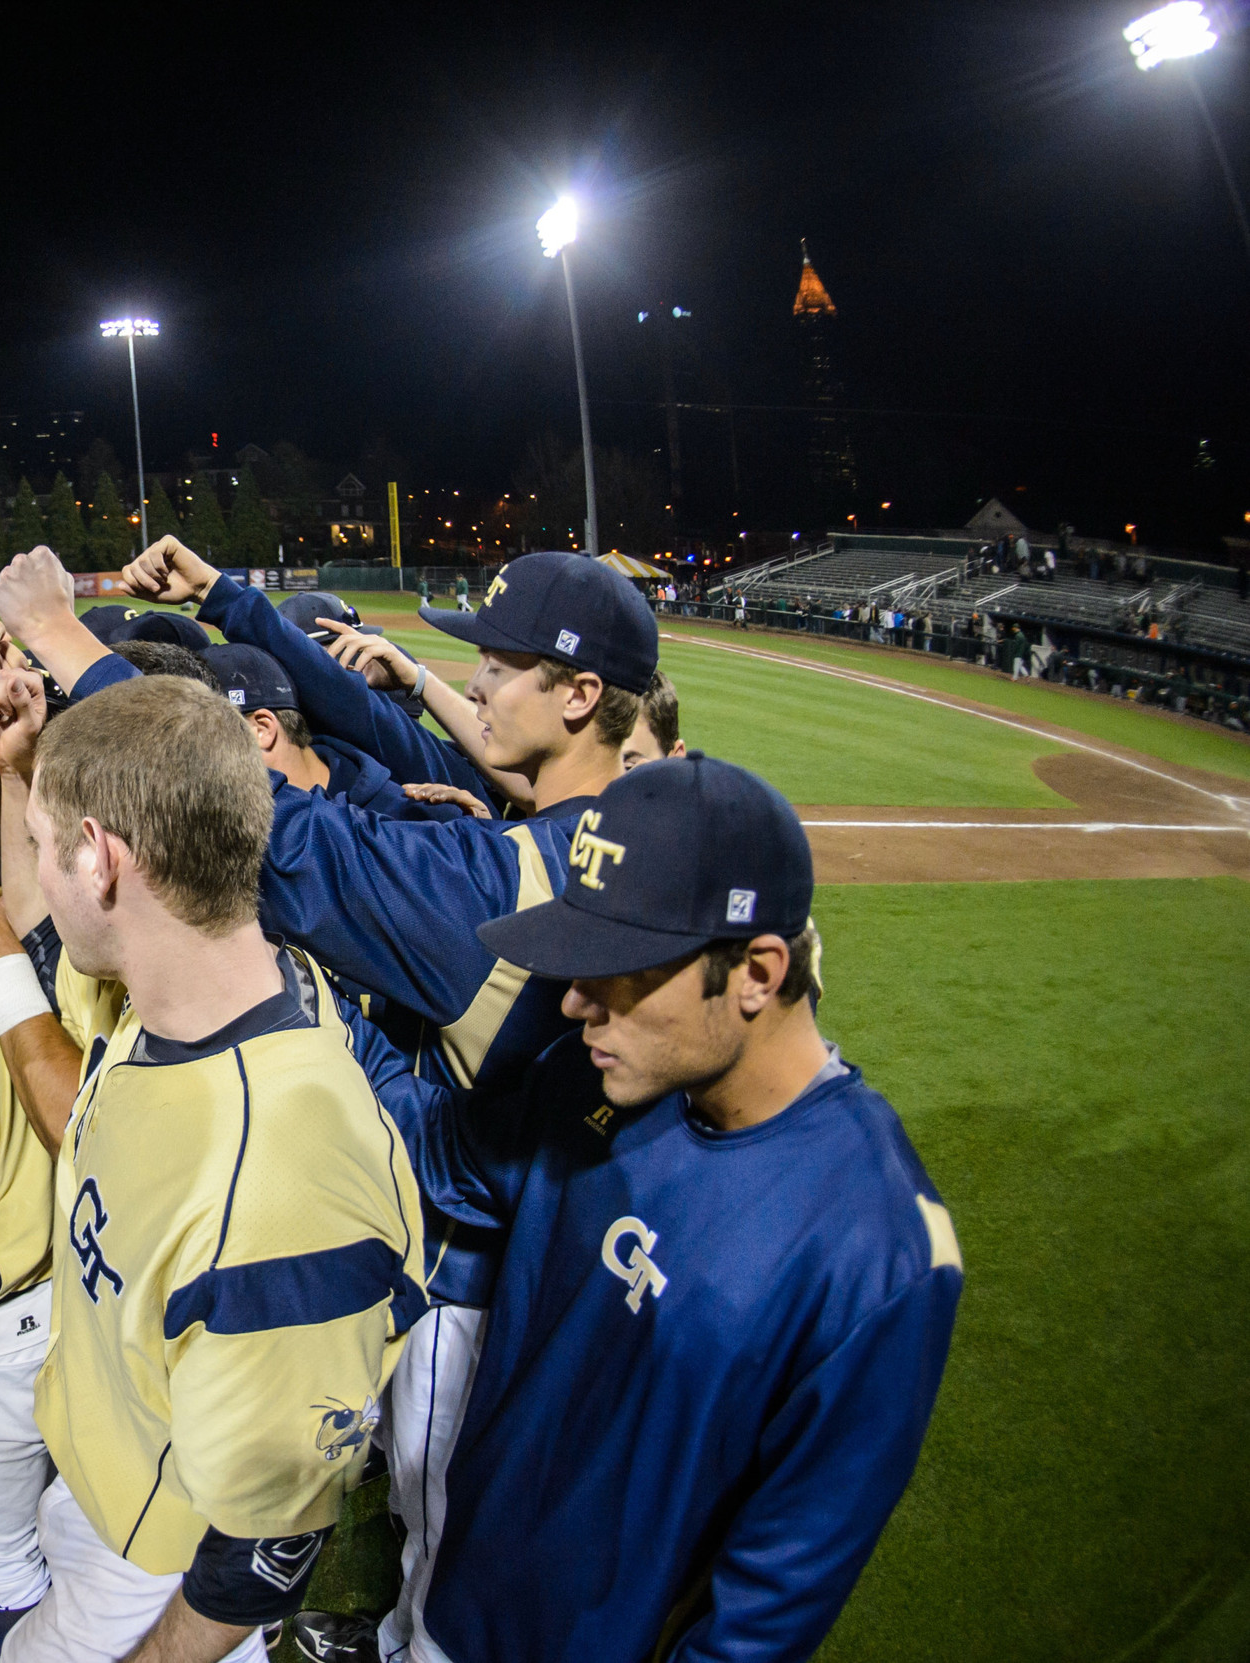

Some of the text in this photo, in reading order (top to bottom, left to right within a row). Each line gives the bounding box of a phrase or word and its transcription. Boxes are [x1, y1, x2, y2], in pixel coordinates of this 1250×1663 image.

[569, 809, 626, 890] GT
[592, 1104, 614, 1125] R
[60, 1175, 124, 1304] GT
[601, 1216, 668, 1314] GT
[20, 1315, 35, 1330] R
